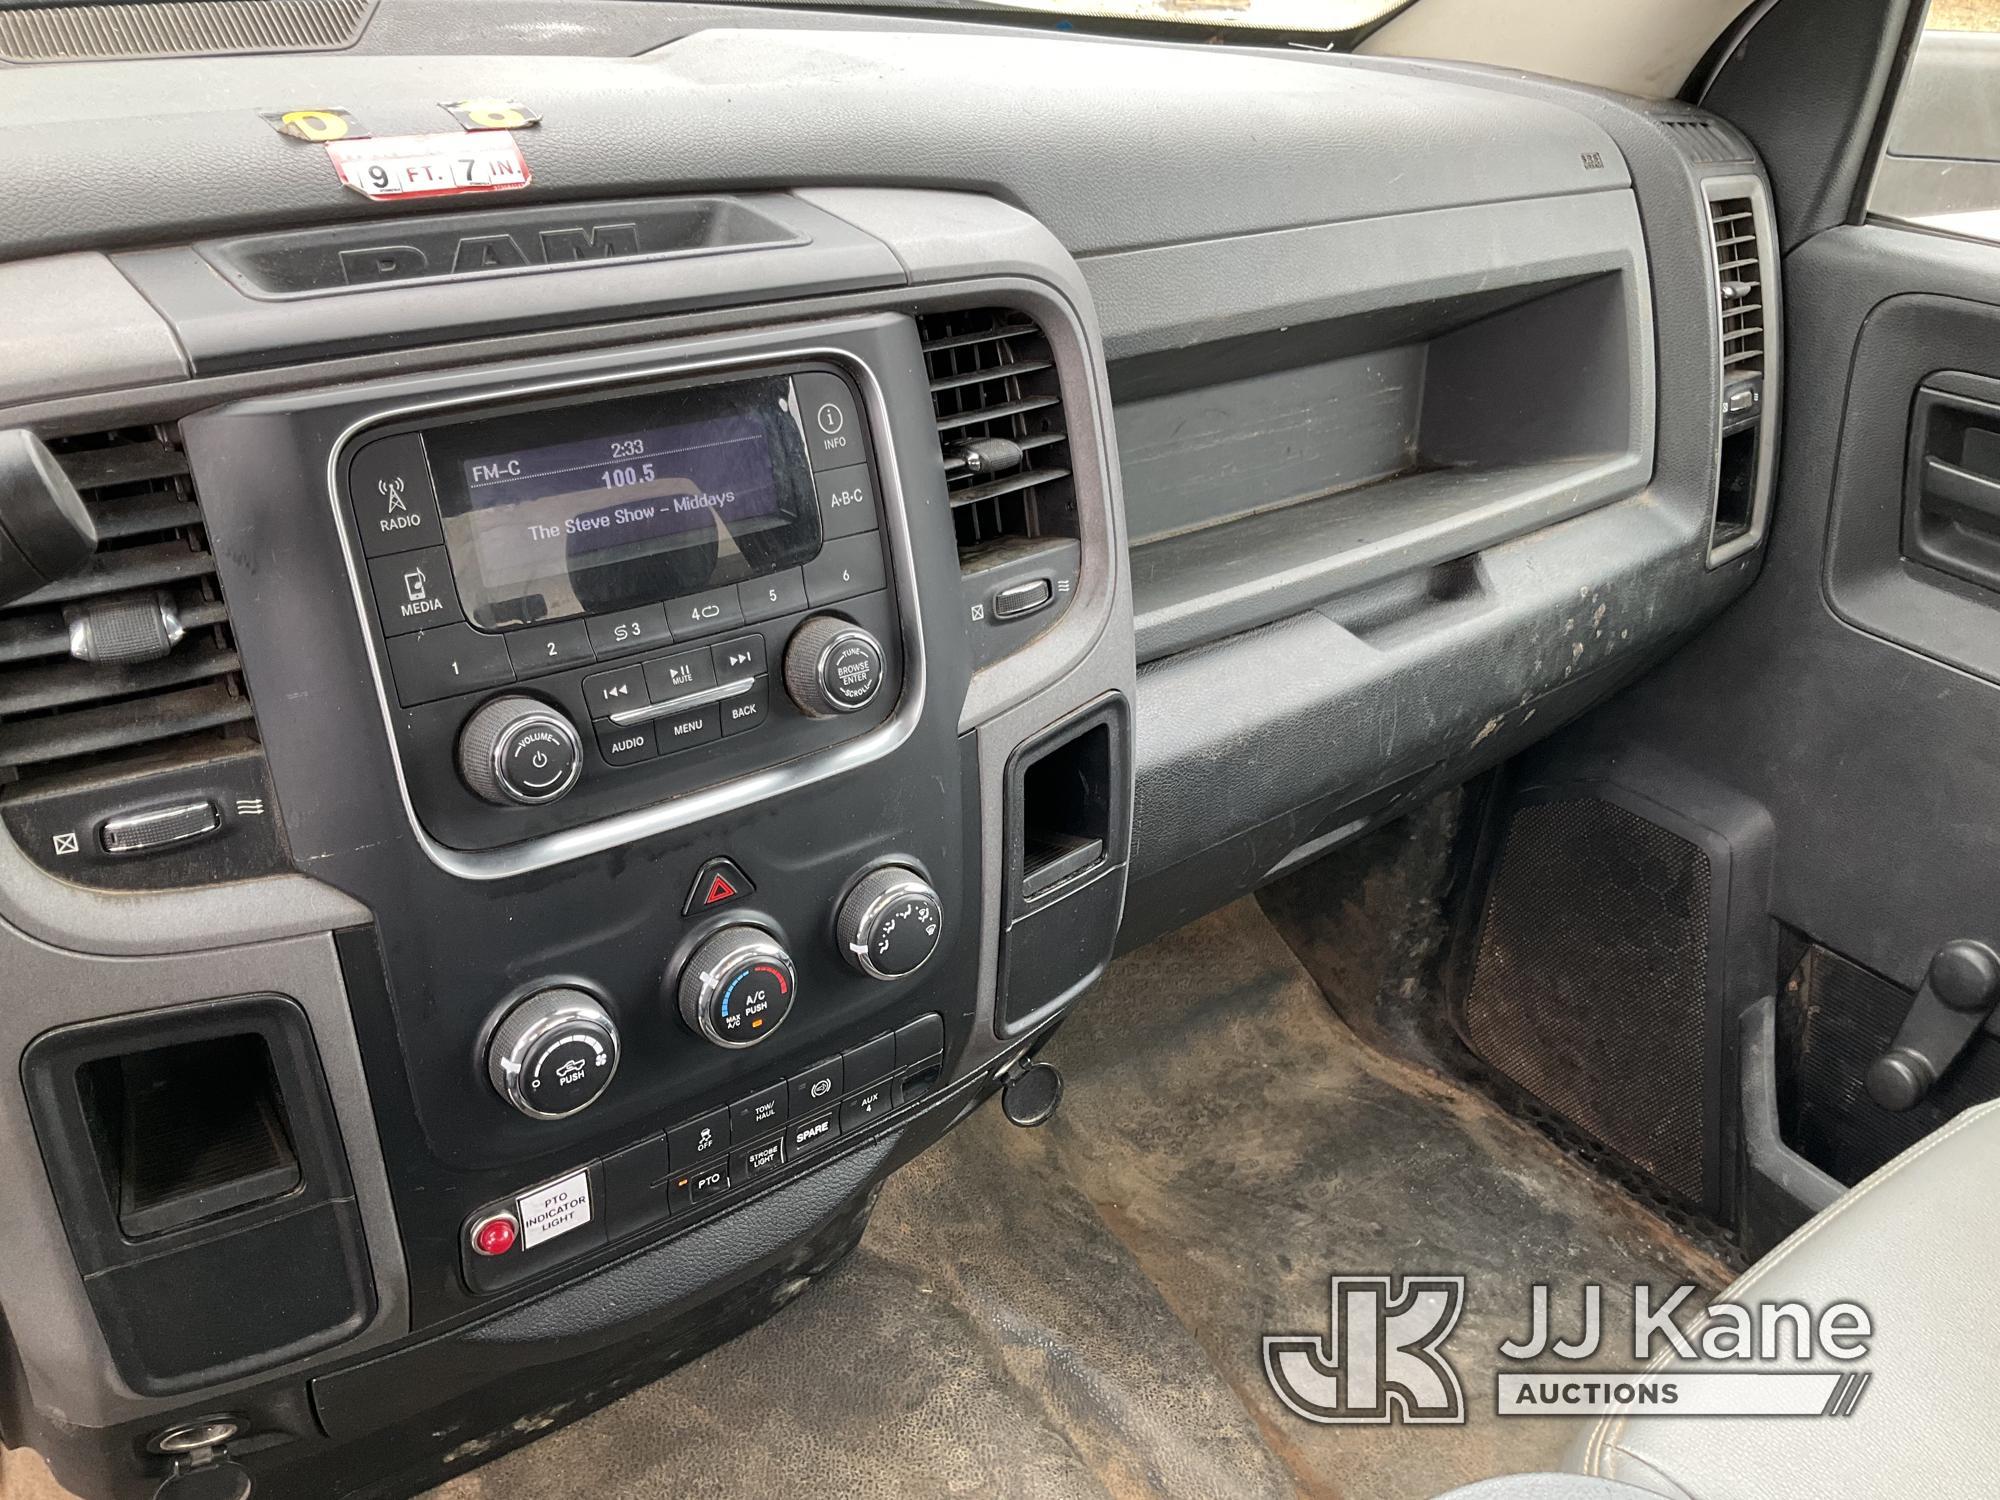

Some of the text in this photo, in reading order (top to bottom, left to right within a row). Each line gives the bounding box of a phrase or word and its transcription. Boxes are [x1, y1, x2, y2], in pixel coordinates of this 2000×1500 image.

[368, 159, 521, 188] 9 FT. 7 IN.
[611, 439, 644, 458] 2:33
[823, 437, 846, 450] INFO
[472, 460, 521, 482] FM-C
[601, 464, 655, 490] 100.5
[380, 513, 421, 532] RADIO
[528, 522, 560, 541] The
[565, 513, 611, 535] Steve
[615, 505, 655, 524] Show
[674, 490, 735, 514] Middays
[842, 570, 850, 581] 6
[769, 589, 777, 602] 5
[401, 598, 443, 617] MEDIA
[691, 607, 700, 621] 4
[631, 622, 641, 635] 3
[547, 642, 557, 656] 2
[842, 647, 861, 658] TUNE
[452, 662, 459, 675] 1
[837, 660, 869, 676] BROWSE
[672, 674, 693, 686] MUTE
[843, 672, 867, 686] ENTER
[845, 685, 869, 698] SCROLL
[731, 703, 757, 720] BACK
[674, 719, 703, 737] MENU
[518, 732, 553, 748] VOLUME
[611, 736, 644, 753] AUDIO
[746, 990, 766, 1006] A/C
[745, 1001, 768, 1017] PUSH
[726, 1013, 741, 1024] MAX
[727, 1020, 741, 1030] A/C
[559, 1069, 585, 1086] PUSH
[755, 1100, 775, 1115] TOW/
[861, 1093, 879, 1107] AUX
[866, 1104, 872, 1112] 4
[756, 1109, 776, 1122] HAUL
[796, 1121, 829, 1143] SPARE
[697, 1140, 713, 1152] OFF
[749, 1146, 778, 1162] STROBE
[753, 1153, 775, 1168] LIGHT
[698, 1173, 720, 1189] PTO
[544, 1192, 568, 1208] PTO
[525, 1195, 586, 1228] INDICATOR
[542, 1211, 575, 1232] LIGHT
